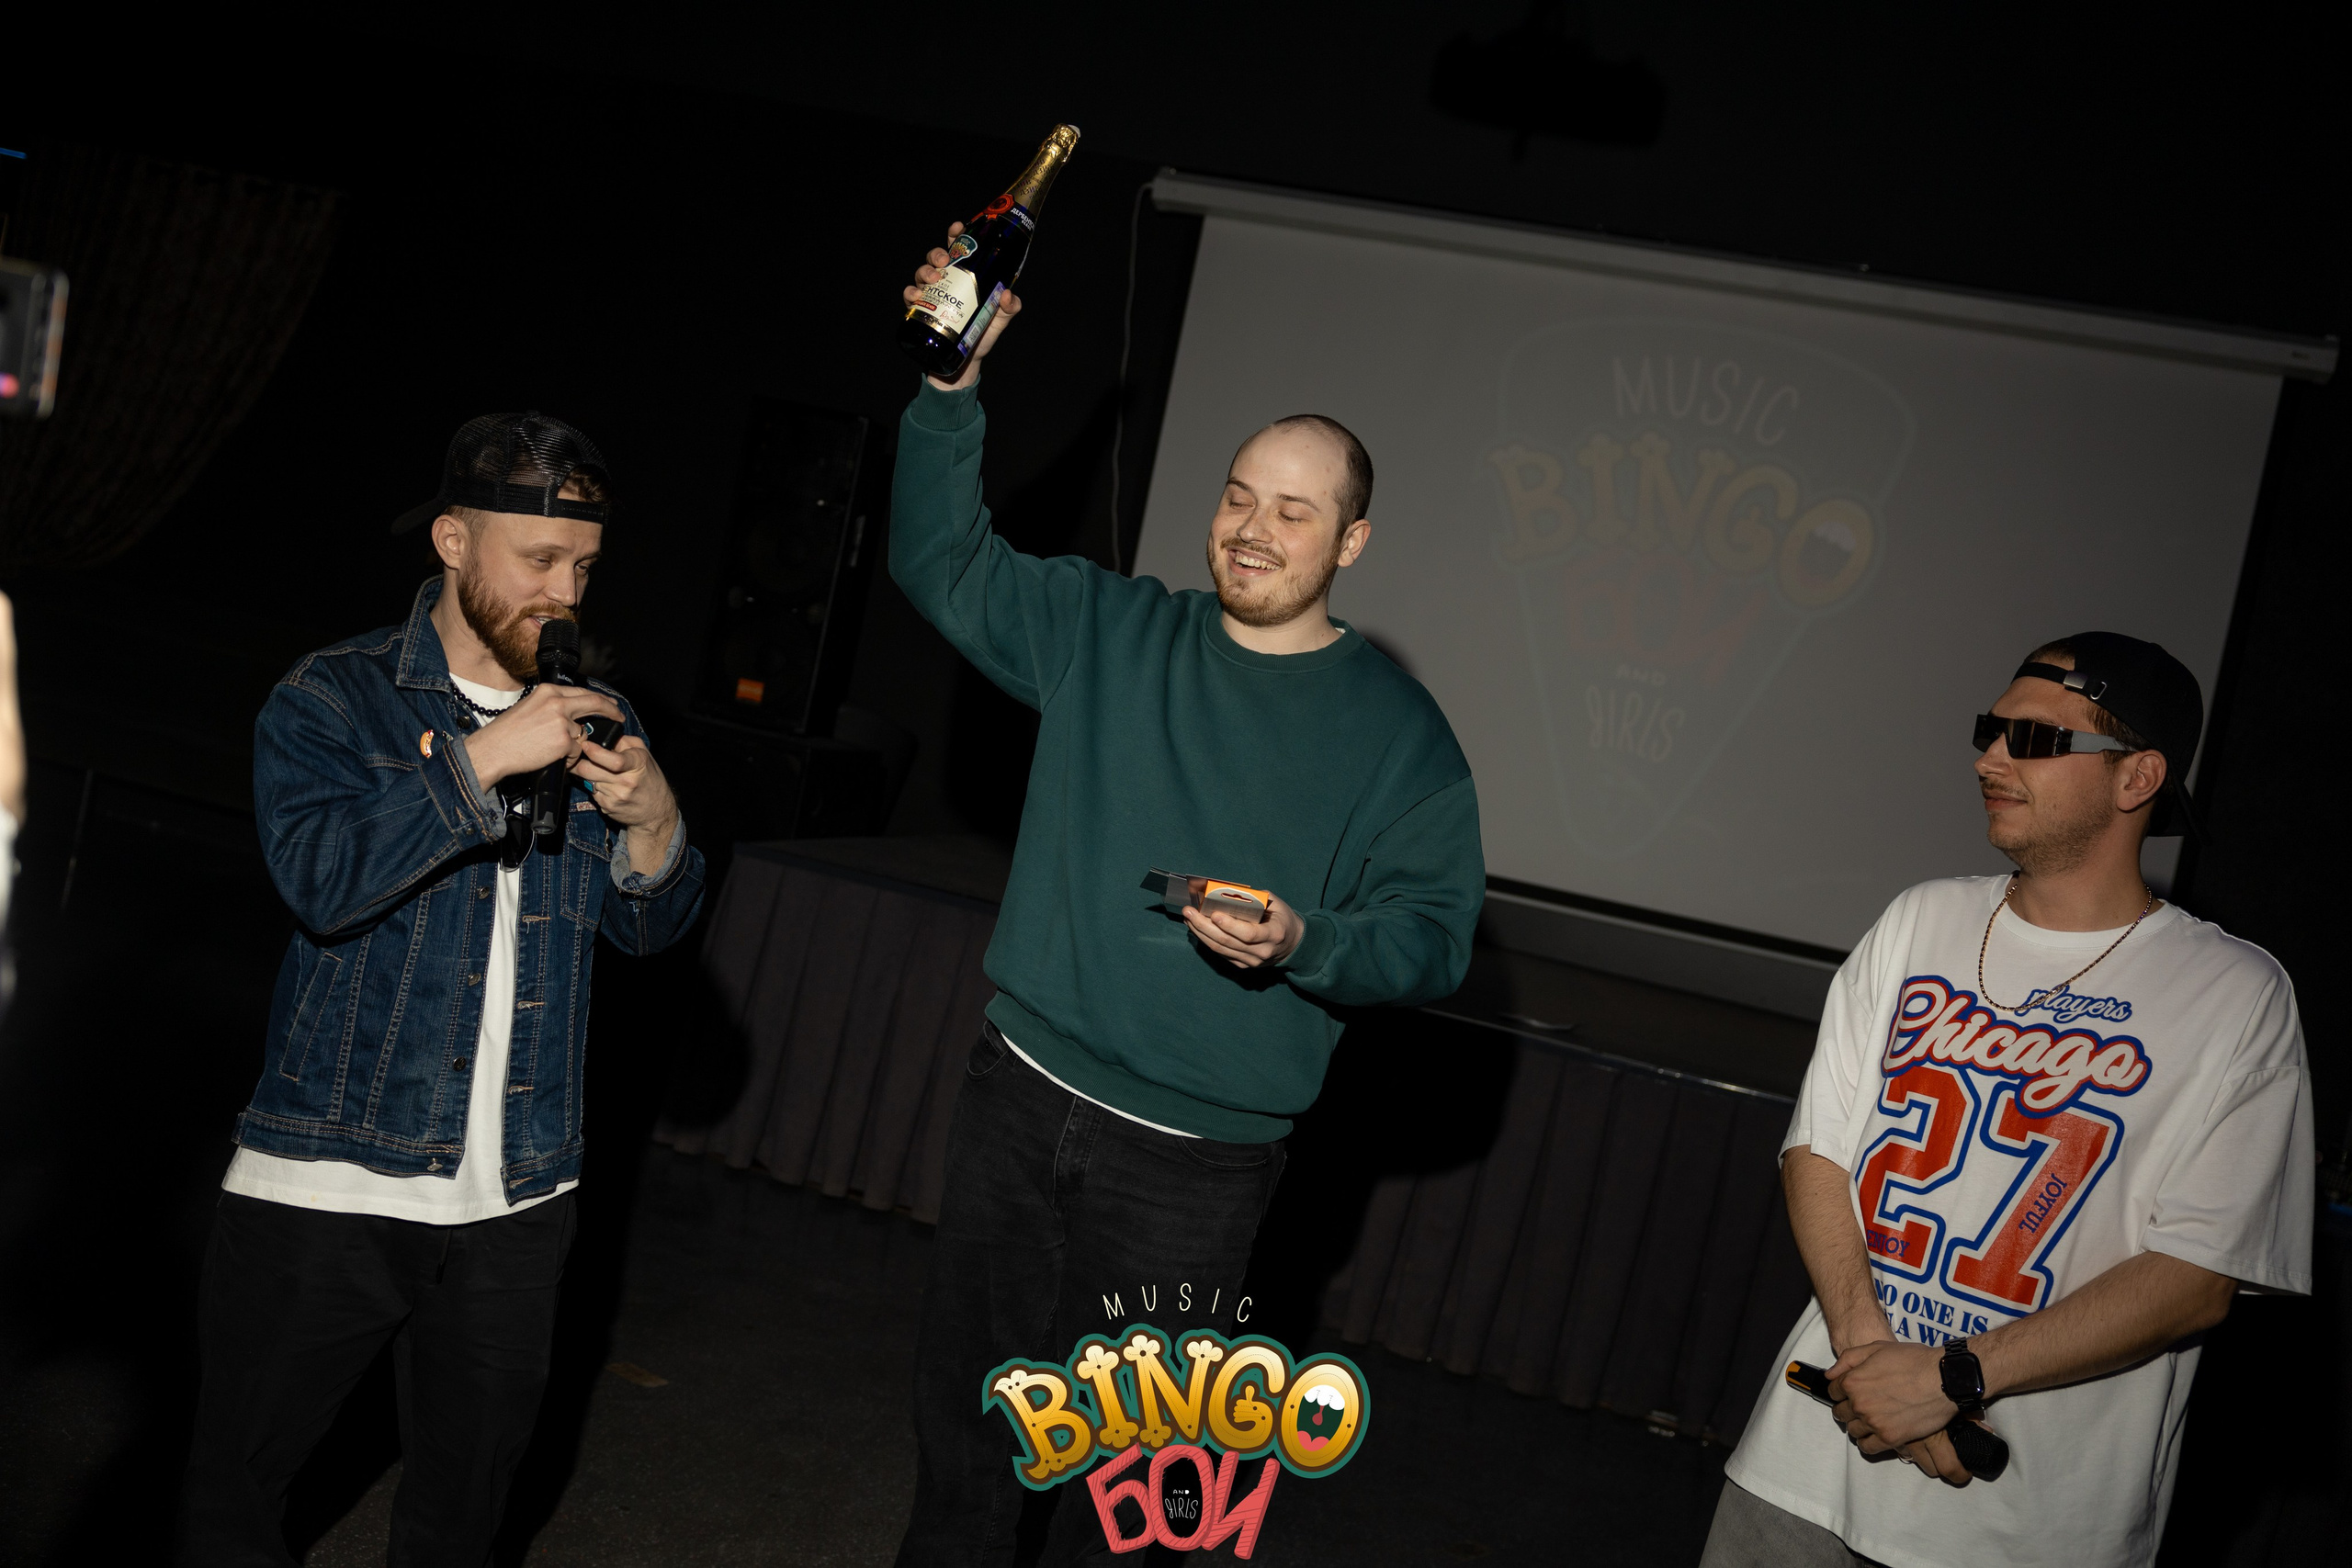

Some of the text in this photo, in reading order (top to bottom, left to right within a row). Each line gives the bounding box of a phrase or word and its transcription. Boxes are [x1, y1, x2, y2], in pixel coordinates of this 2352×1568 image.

[1611, 354, 1800, 446] MUSIC
[1488, 431, 1875, 608] BINGO
[2014, 983, 2132, 1023] players
[1883, 976, 2151, 1117] Chicago
[1857, 1064, 2122, 1314] 27
[2018, 1173, 2067, 1234] JOYFUL
[1867, 1229, 1910, 1257] ENJOY
[1895, 1316, 1911, 1339] A
[1903, 1292, 1954, 1327] ONE
[1960, 1311, 1988, 1336] IS
